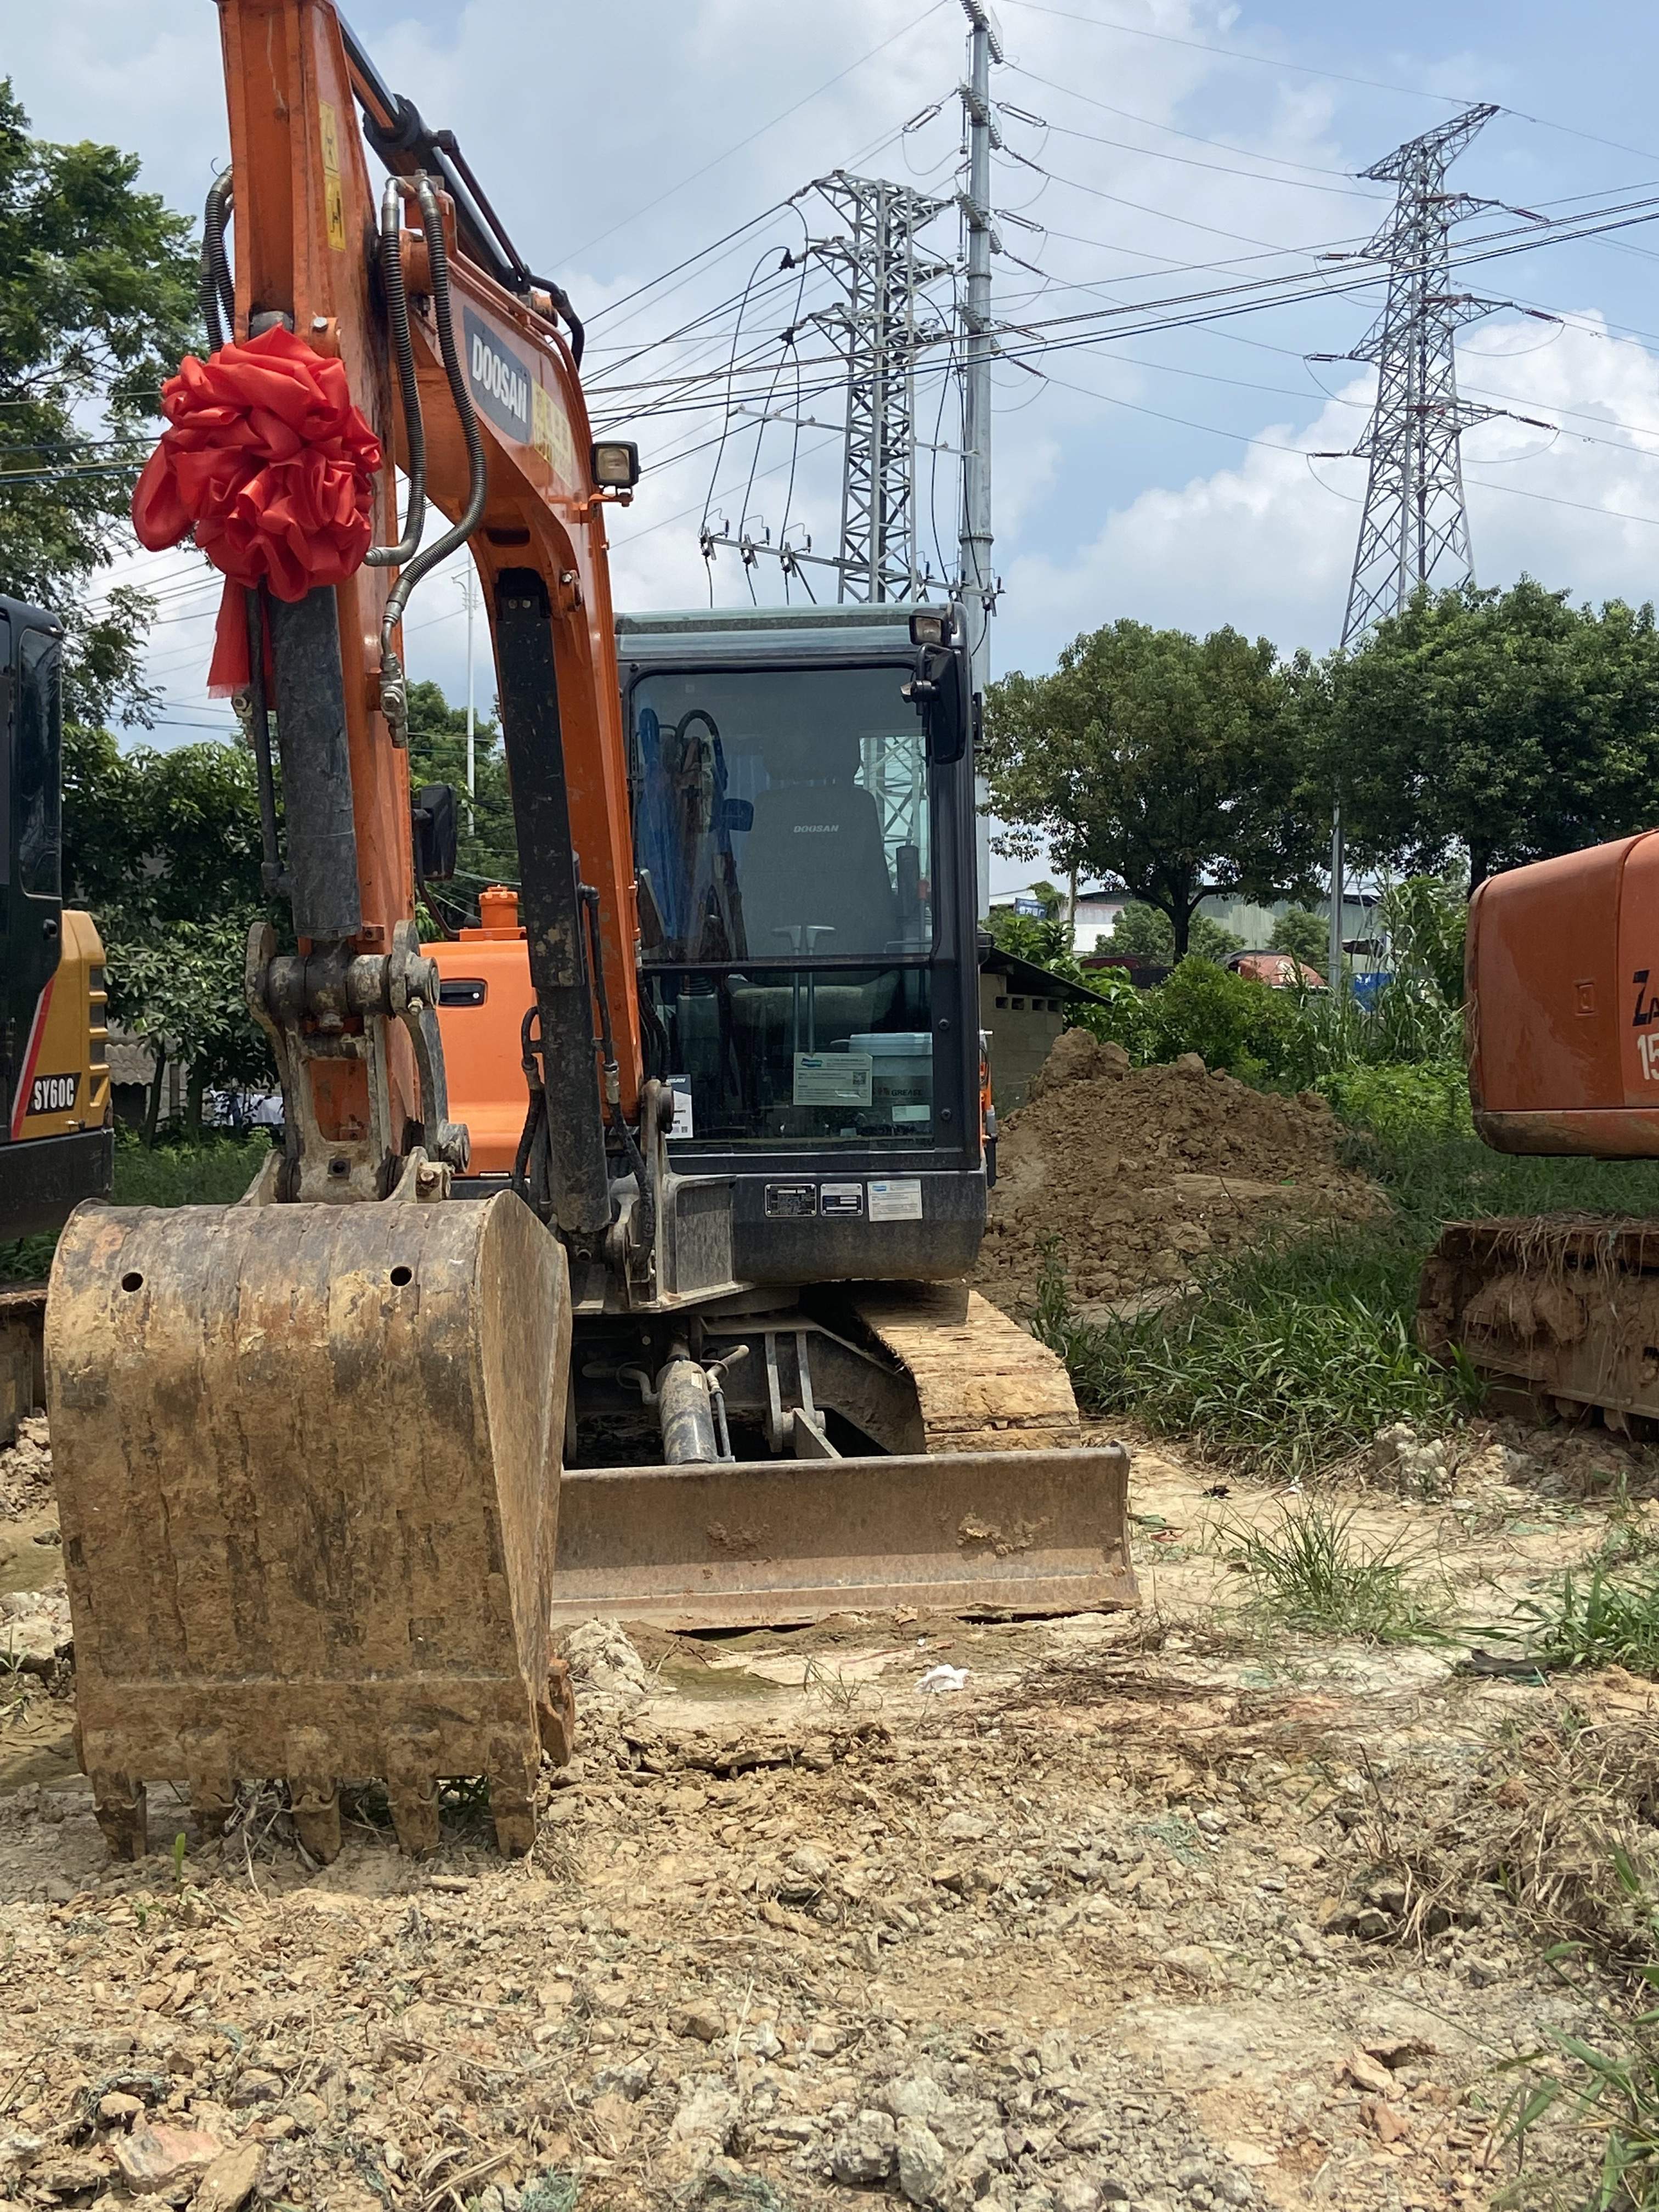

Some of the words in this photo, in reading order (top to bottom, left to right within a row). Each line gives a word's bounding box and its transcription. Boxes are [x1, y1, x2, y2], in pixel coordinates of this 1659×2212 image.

[472, 334, 527, 423] DOOSAN
[793, 825, 839, 833] DOOSAN
[34, 1077, 75, 1110] SY60C
